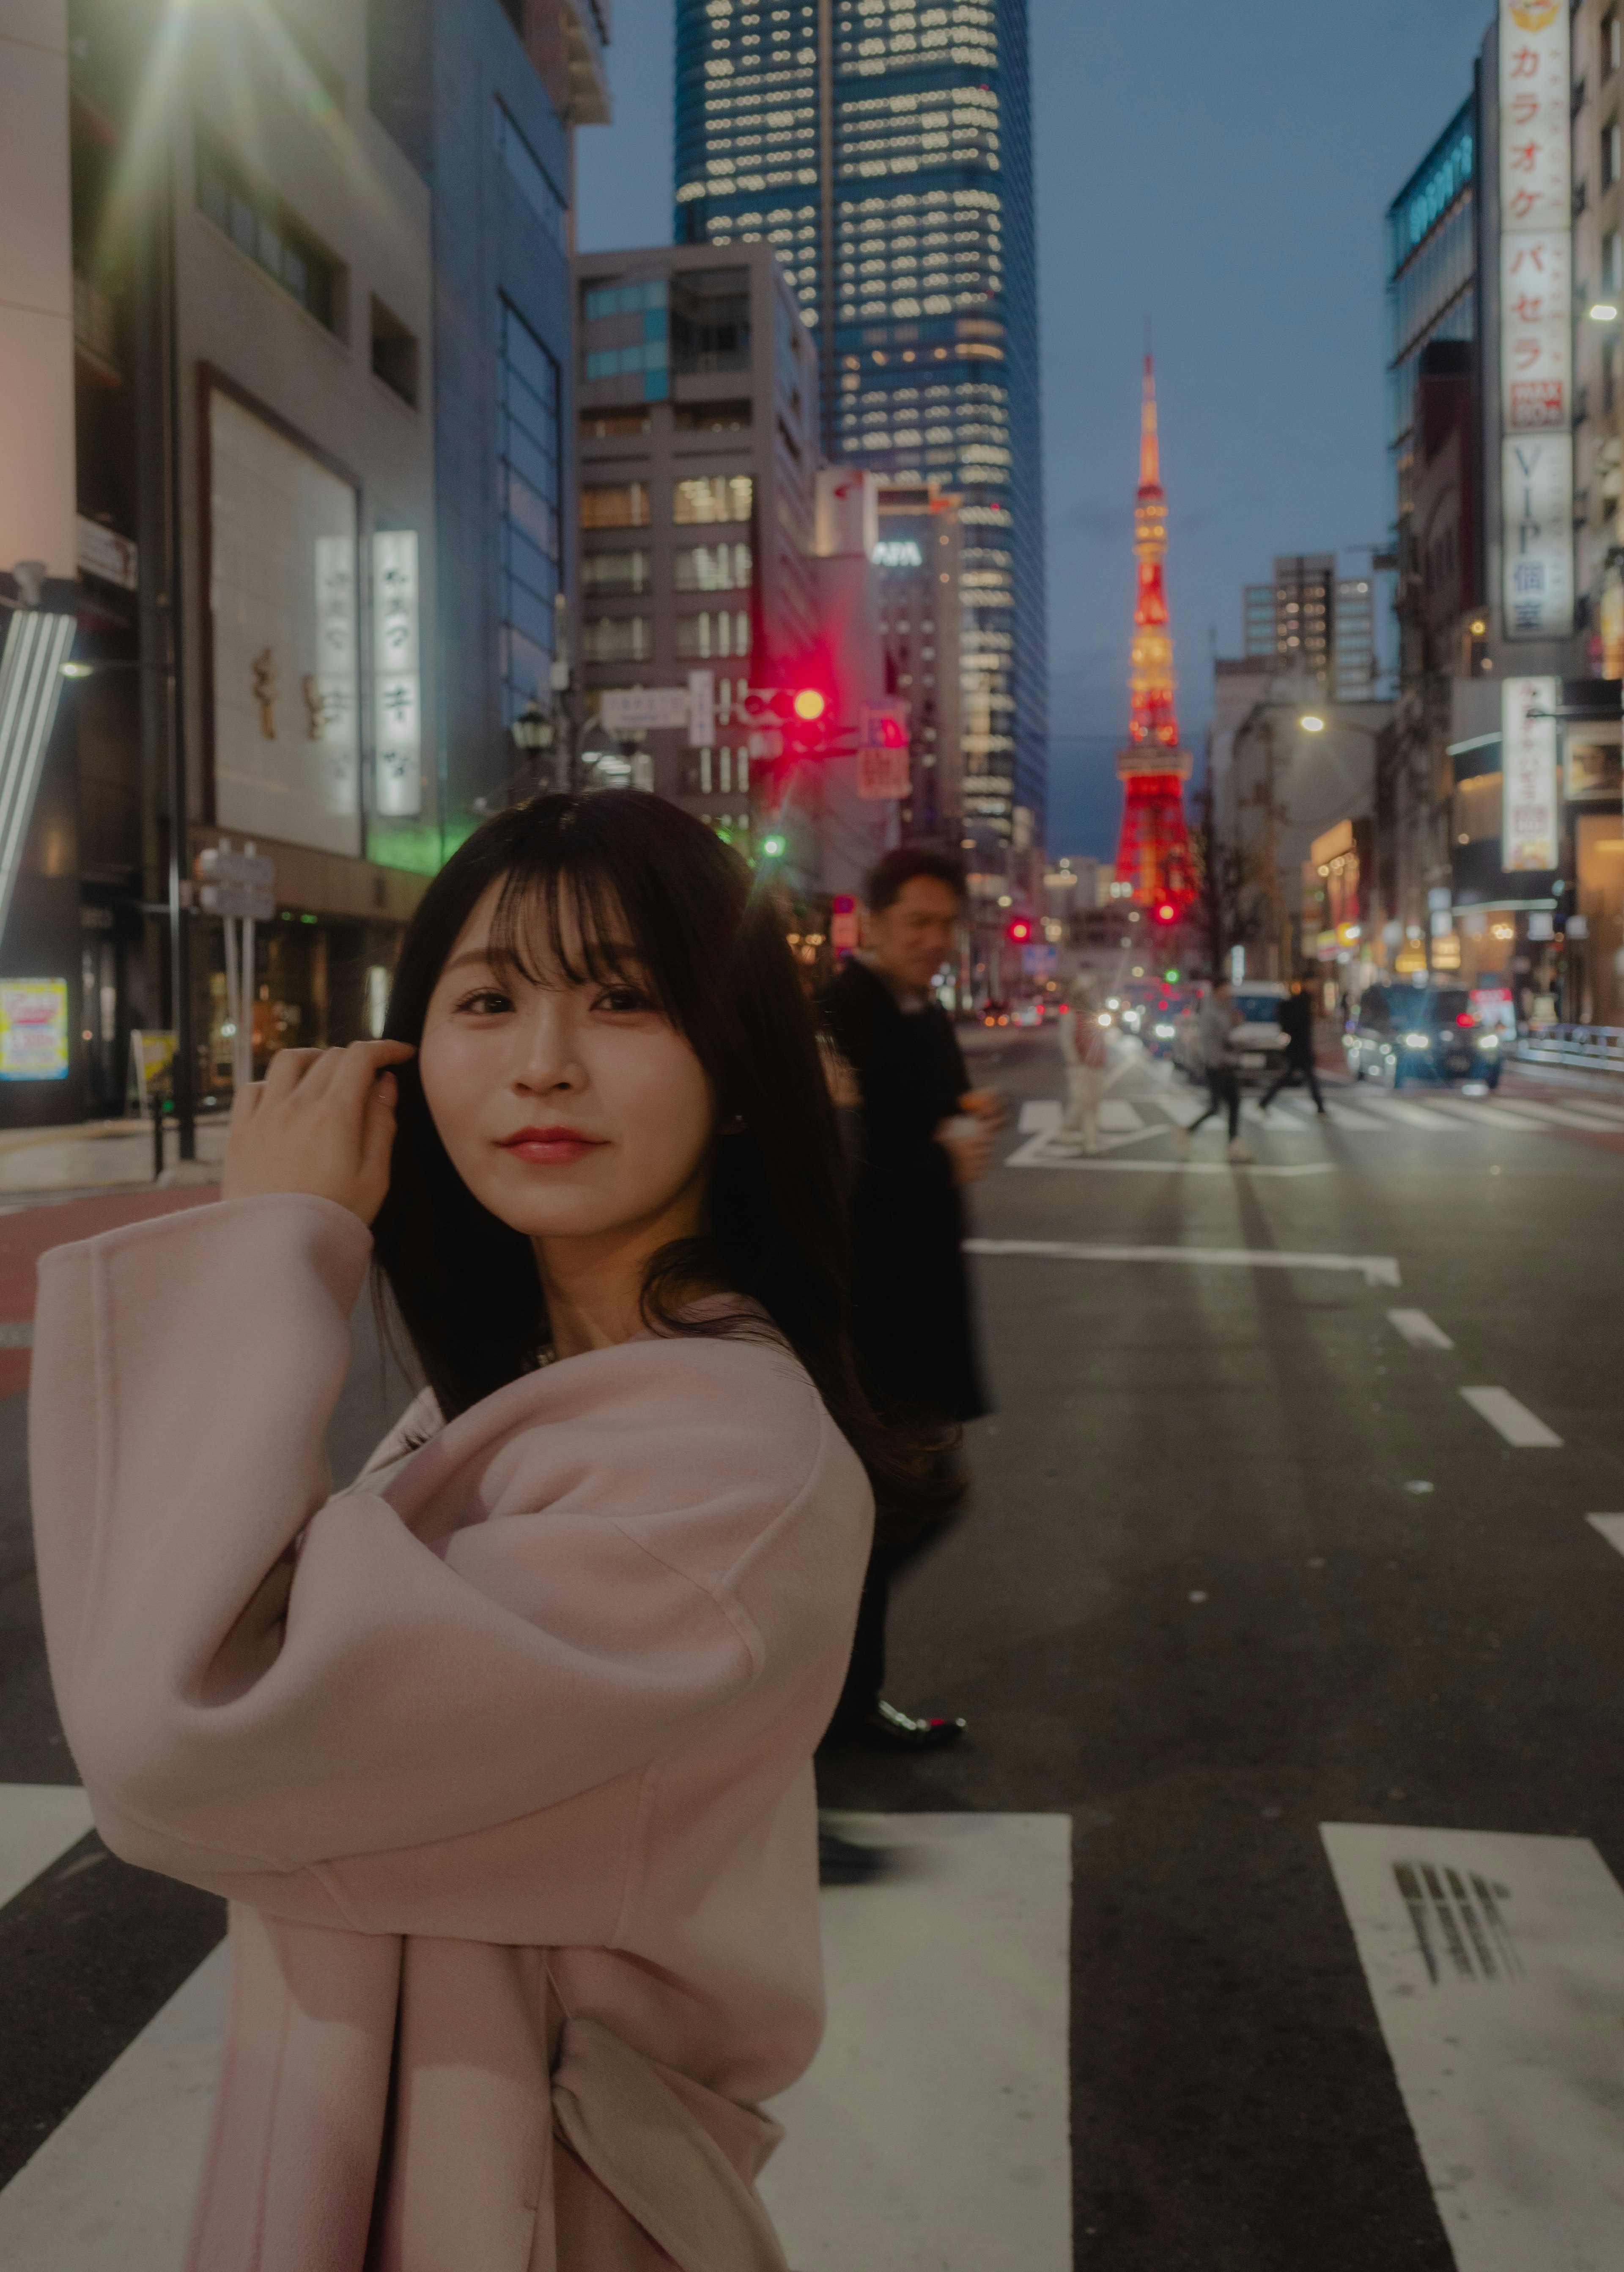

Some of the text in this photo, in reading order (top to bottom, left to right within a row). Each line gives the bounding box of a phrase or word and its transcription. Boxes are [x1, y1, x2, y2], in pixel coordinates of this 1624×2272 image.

[1510, 44, 1542, 219] カラオケ
[1510, 243, 1544, 370] パセラ
[871, 541, 922, 567] APA
